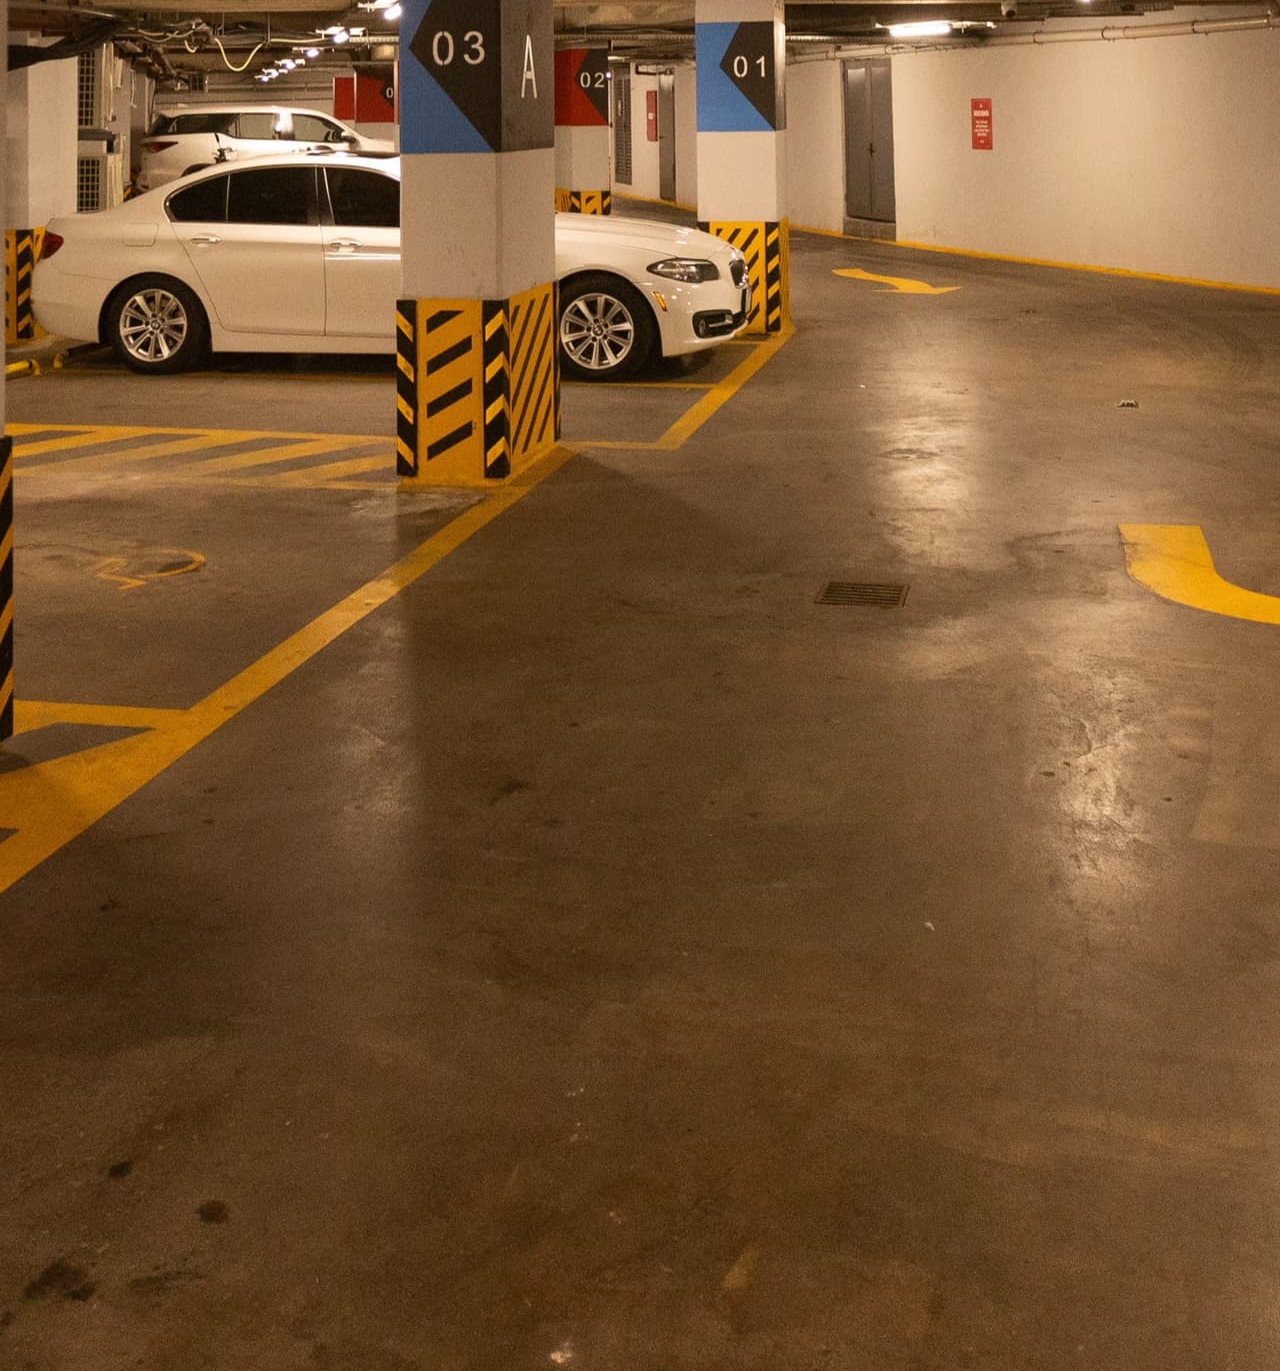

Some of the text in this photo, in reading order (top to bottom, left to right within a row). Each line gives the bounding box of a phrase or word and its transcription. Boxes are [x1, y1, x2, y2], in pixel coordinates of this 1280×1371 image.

[431, 30, 486, 66] 03
[521, 34, 538, 99] A
[733, 55, 766, 78] 01
[580, 71, 605, 88] 02
[386, 87, 394, 98] 0
